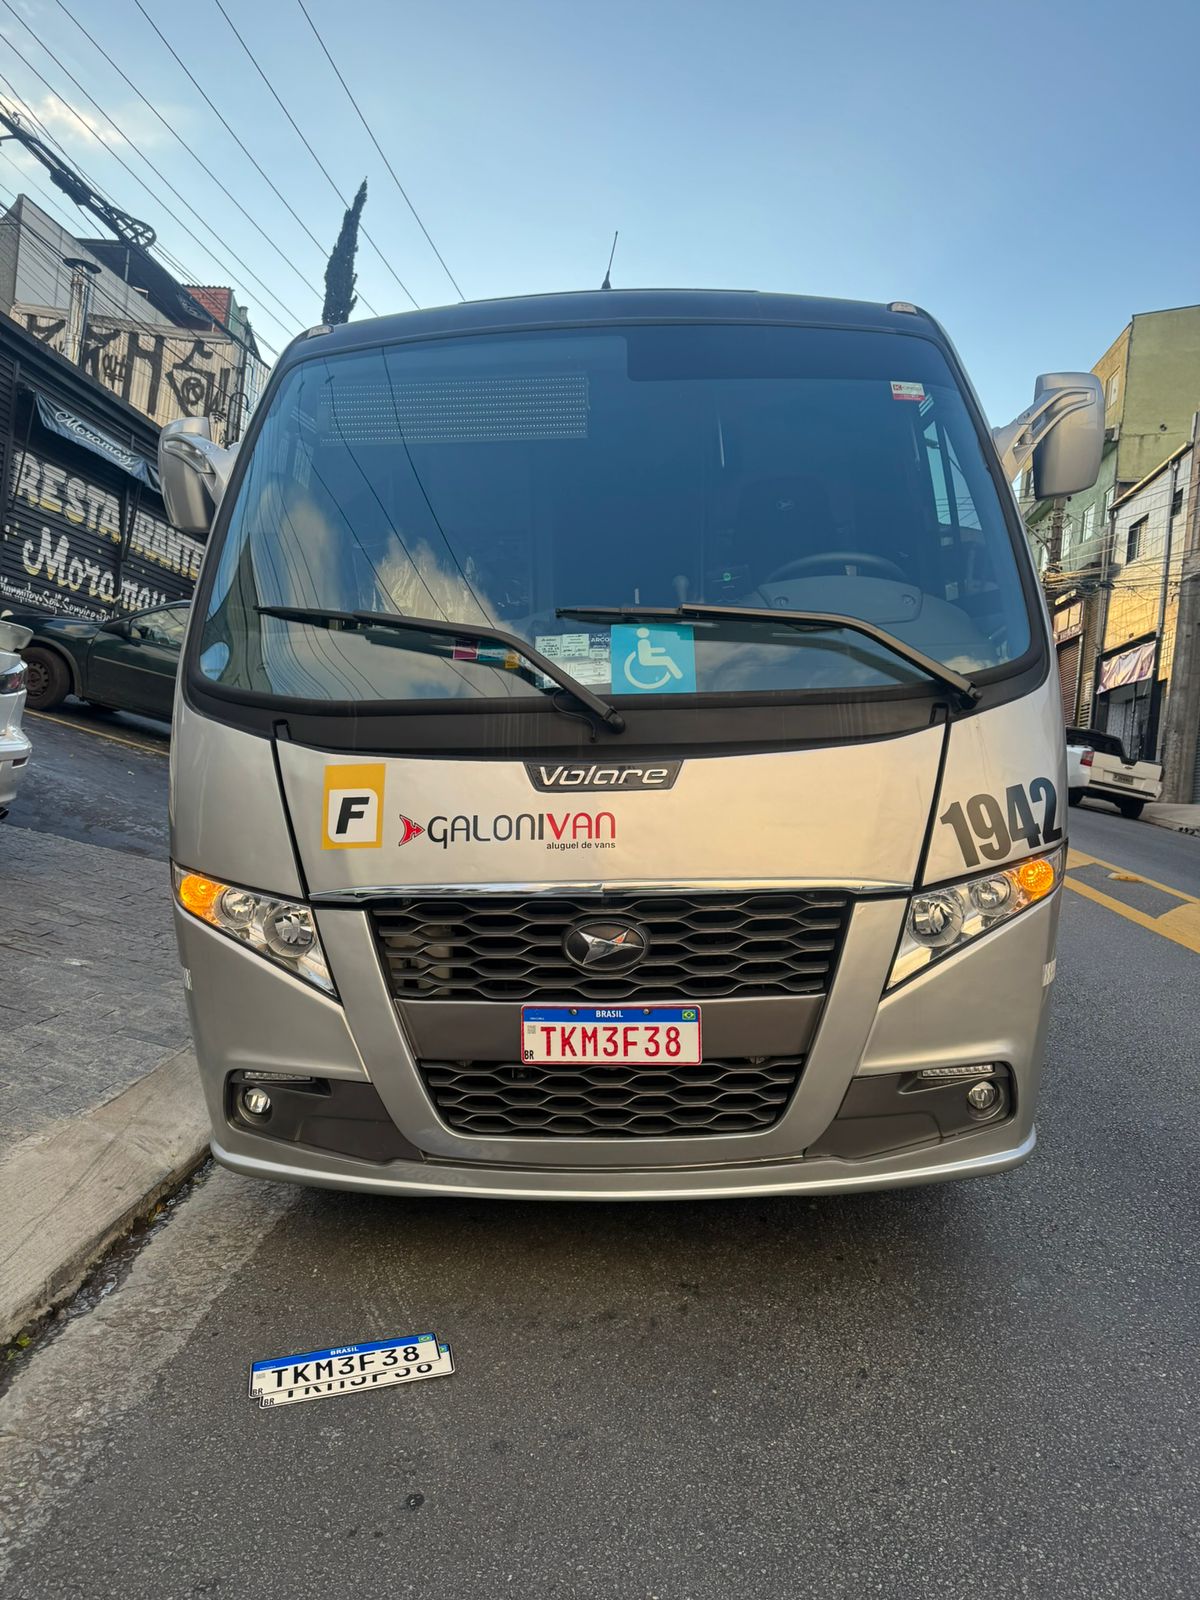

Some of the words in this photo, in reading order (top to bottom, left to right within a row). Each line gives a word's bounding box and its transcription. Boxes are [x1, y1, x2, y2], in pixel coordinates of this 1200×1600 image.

[539, 765, 668, 787] Volare
[335, 796, 370, 835] F
[939, 776, 1063, 868] 1942
[546, 842, 579, 851] aluguel
[595, 1009, 624, 1018] BRASIL
[540, 1026, 682, 1057] TKM3F38
[524, 1050, 534, 1060] BR
[330, 1346, 359, 1356] BRASIL
[271, 1346, 420, 1388] TKM3F38
[252, 1388, 263, 1396] BR
[263, 1398, 275, 1406] BR
